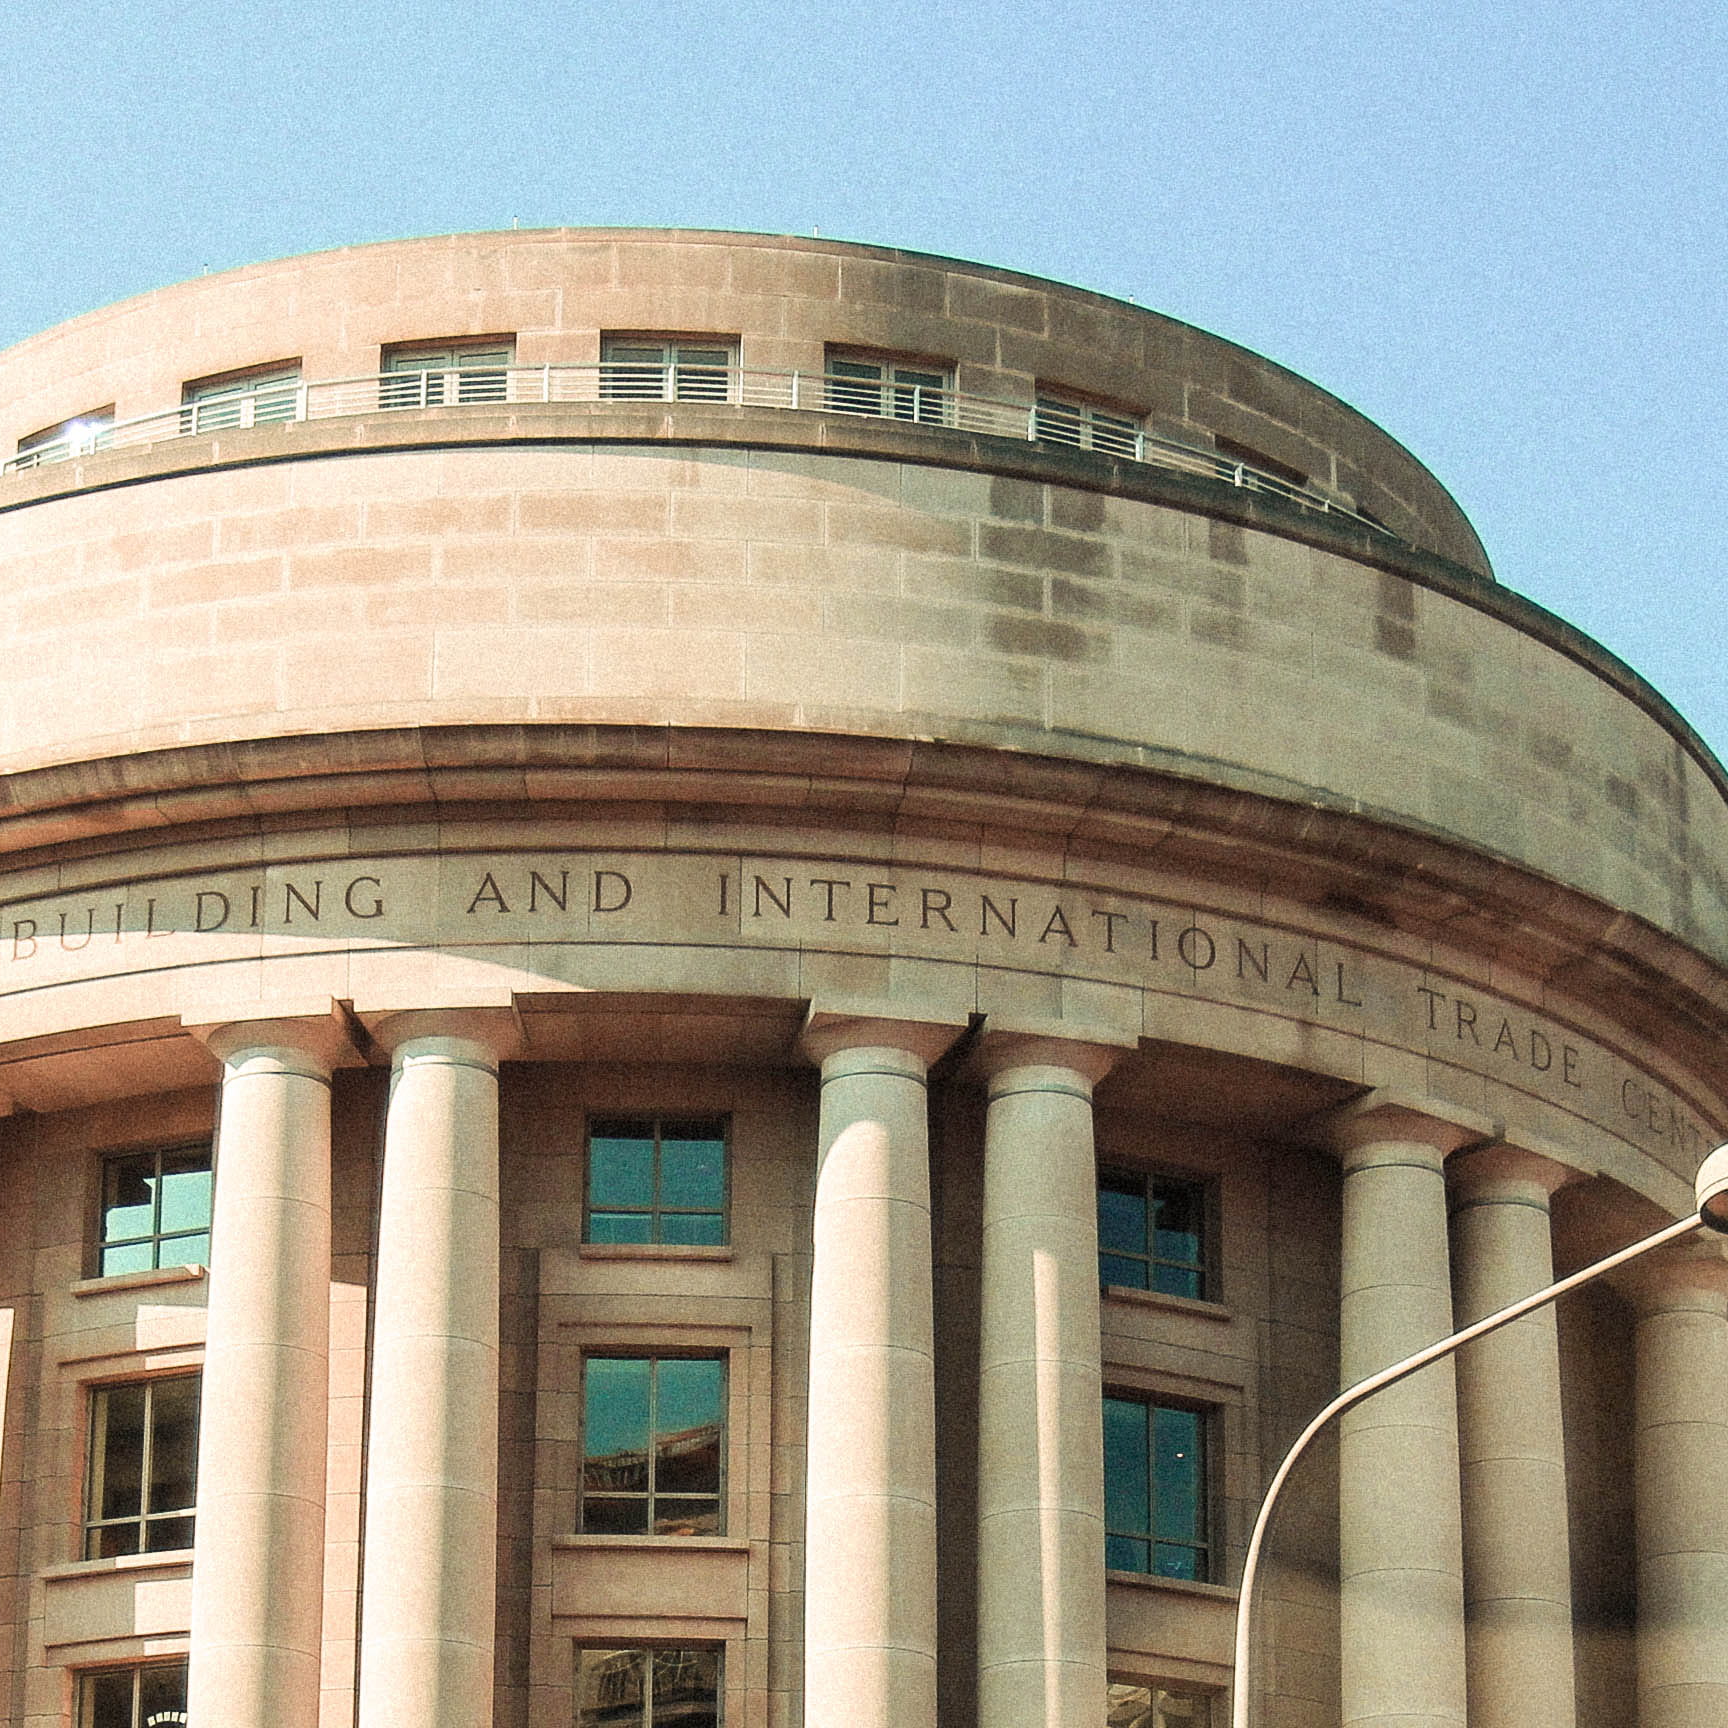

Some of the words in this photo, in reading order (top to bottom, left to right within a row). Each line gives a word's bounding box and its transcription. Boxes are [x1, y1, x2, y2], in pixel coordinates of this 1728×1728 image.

[12, 875, 386, 962] BUILDING
[467, 869, 634, 914] AND
[718, 872, 1364, 1009] INTERNATIONAL
[1416, 985, 1582, 1088] TRADE
